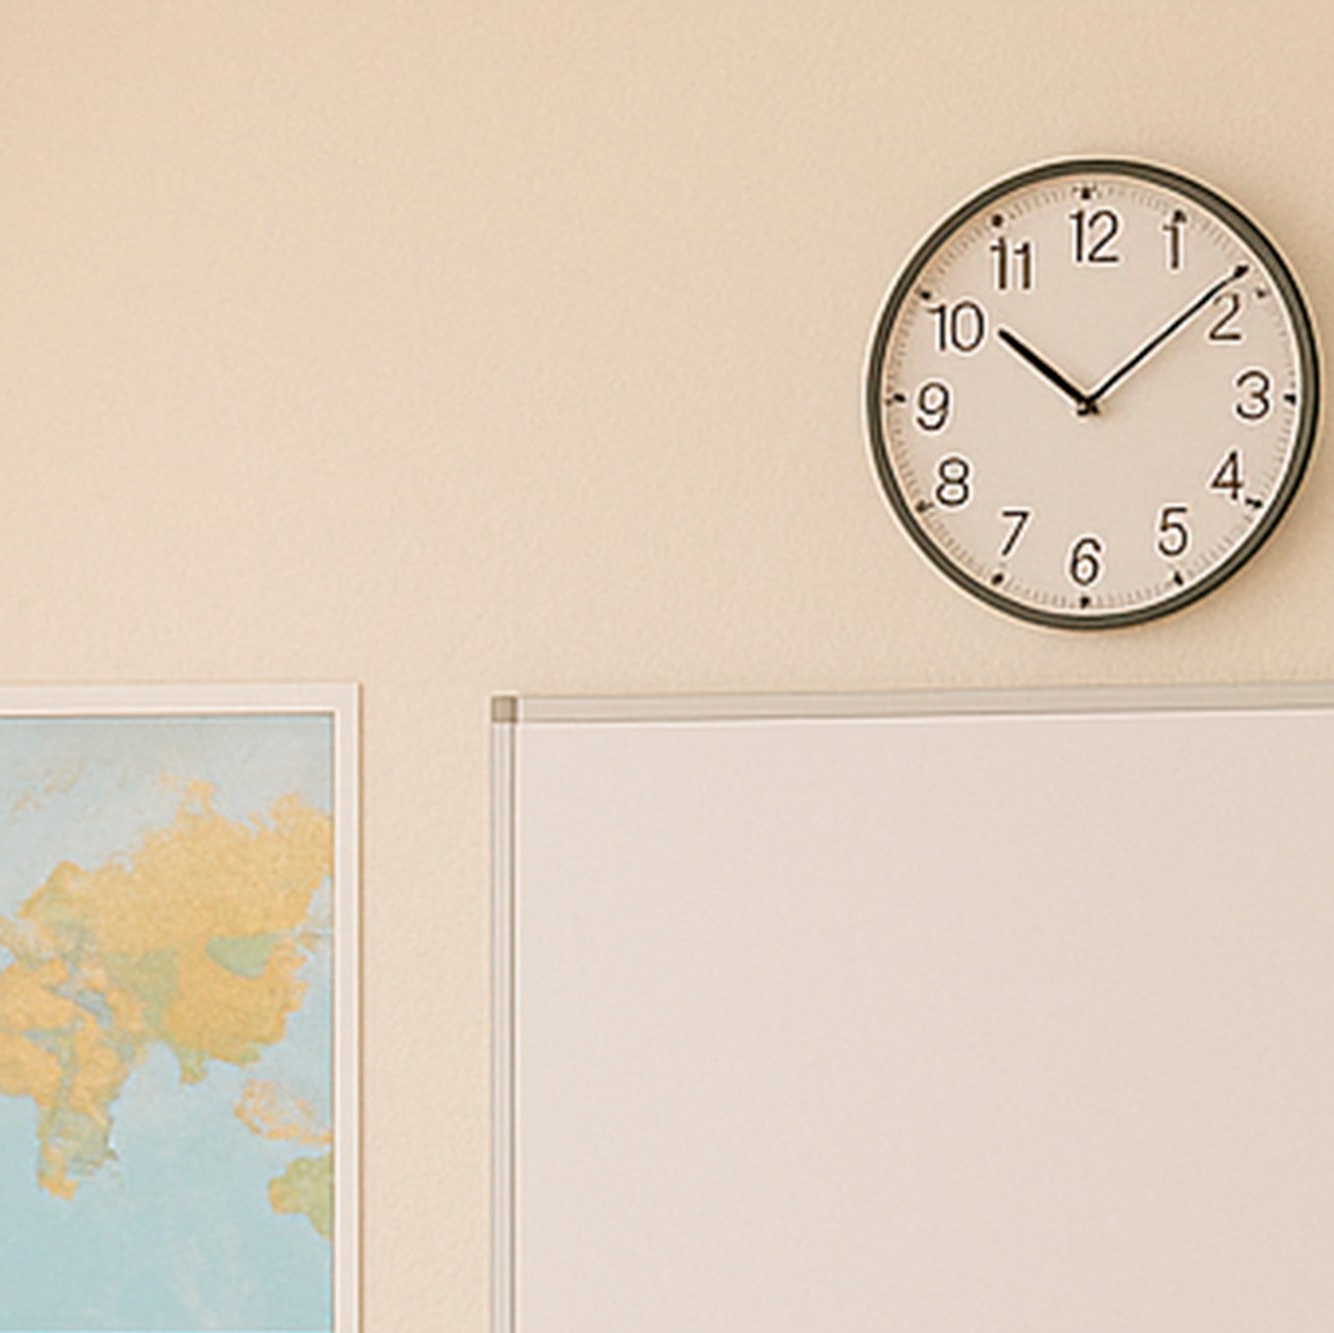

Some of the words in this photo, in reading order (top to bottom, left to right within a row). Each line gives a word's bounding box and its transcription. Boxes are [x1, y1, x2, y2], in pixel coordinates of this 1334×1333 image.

[1069, 210, 1118, 262] 12
[1163, 220, 1183, 270] 1
[990, 237, 1030, 290] 11
[928, 301, 984, 352] 10
[1209, 294, 1241, 340] 2
[917, 383, 949, 431] 9
[1237, 371, 1269, 420] 3
[936, 458, 969, 507] 8
[1211, 451, 1243, 500] 4
[1002, 511, 1029, 556] 7
[1159, 507, 1187, 556] 5
[1070, 538, 1101, 586] 6
